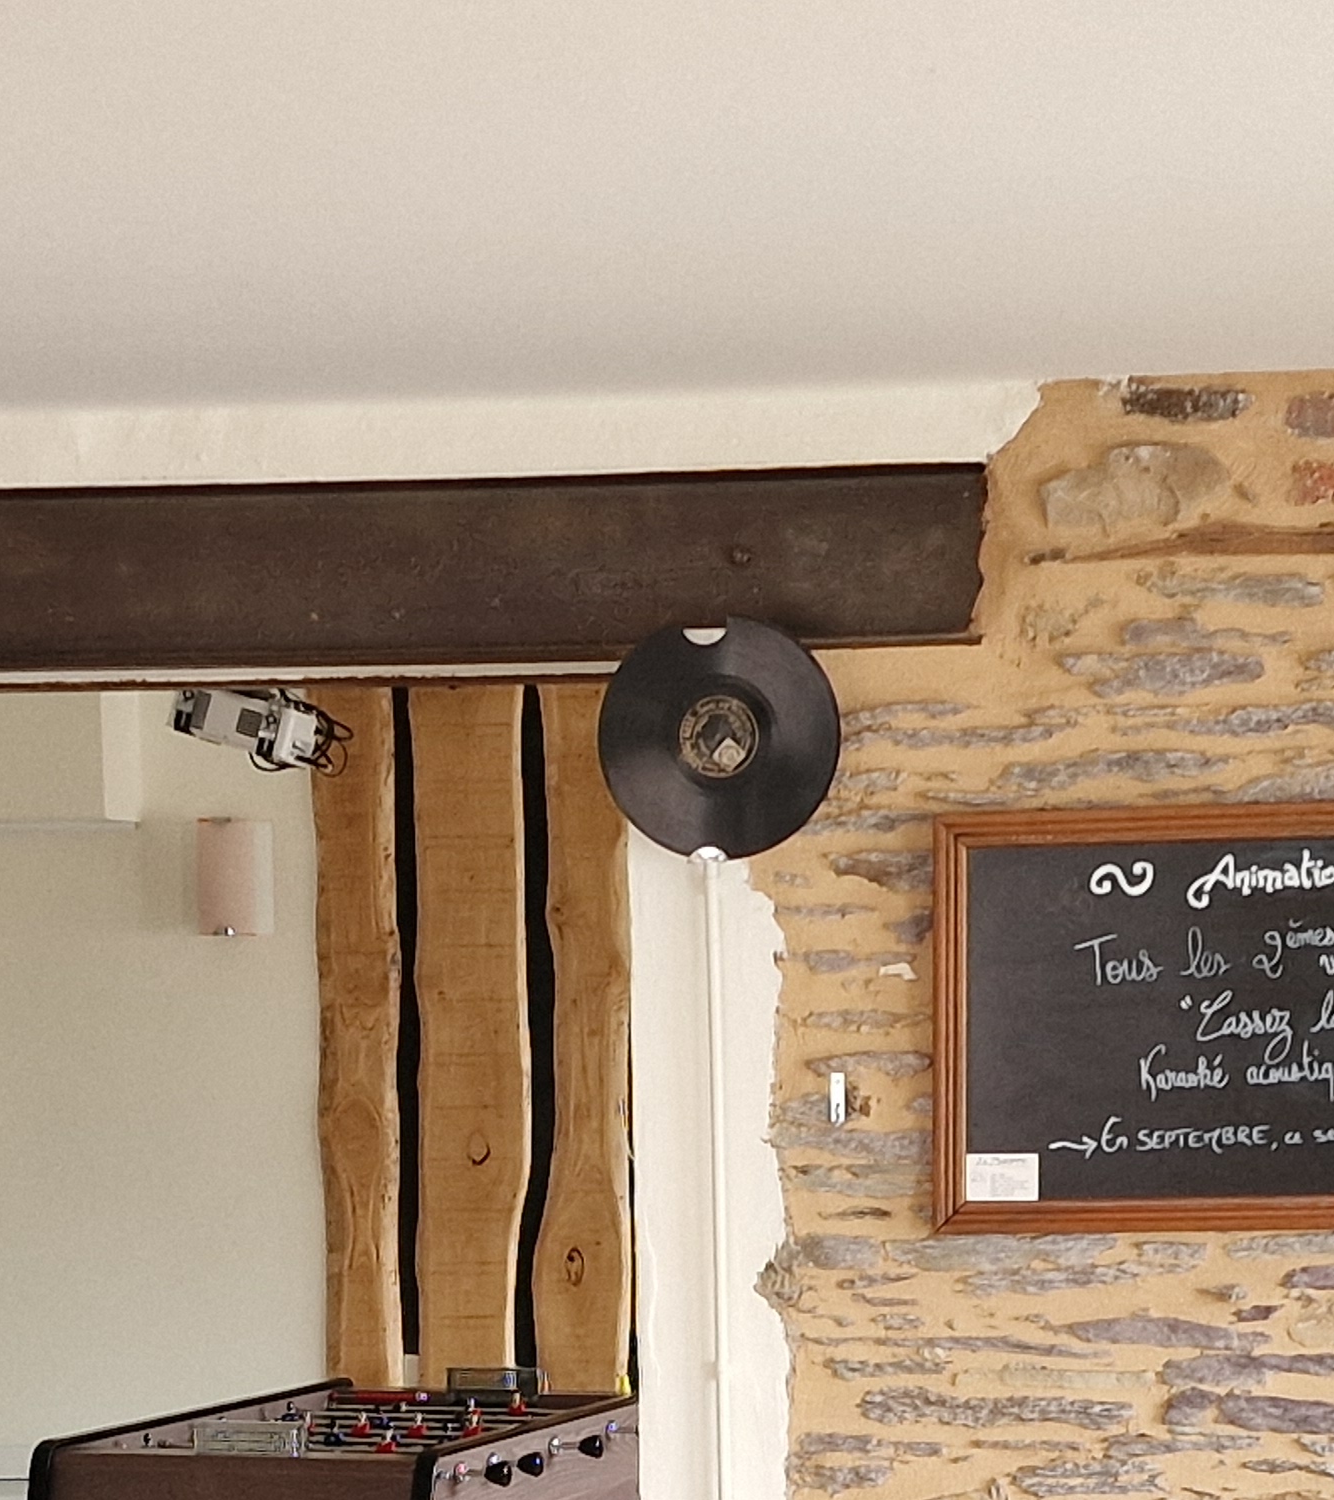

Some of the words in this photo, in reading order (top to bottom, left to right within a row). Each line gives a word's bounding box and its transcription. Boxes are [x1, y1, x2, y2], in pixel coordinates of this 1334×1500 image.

[1073, 932, 1164, 986] Tous
[1179, 925, 1232, 978] les
[1139, 1043, 1230, 1103] Karaoké
